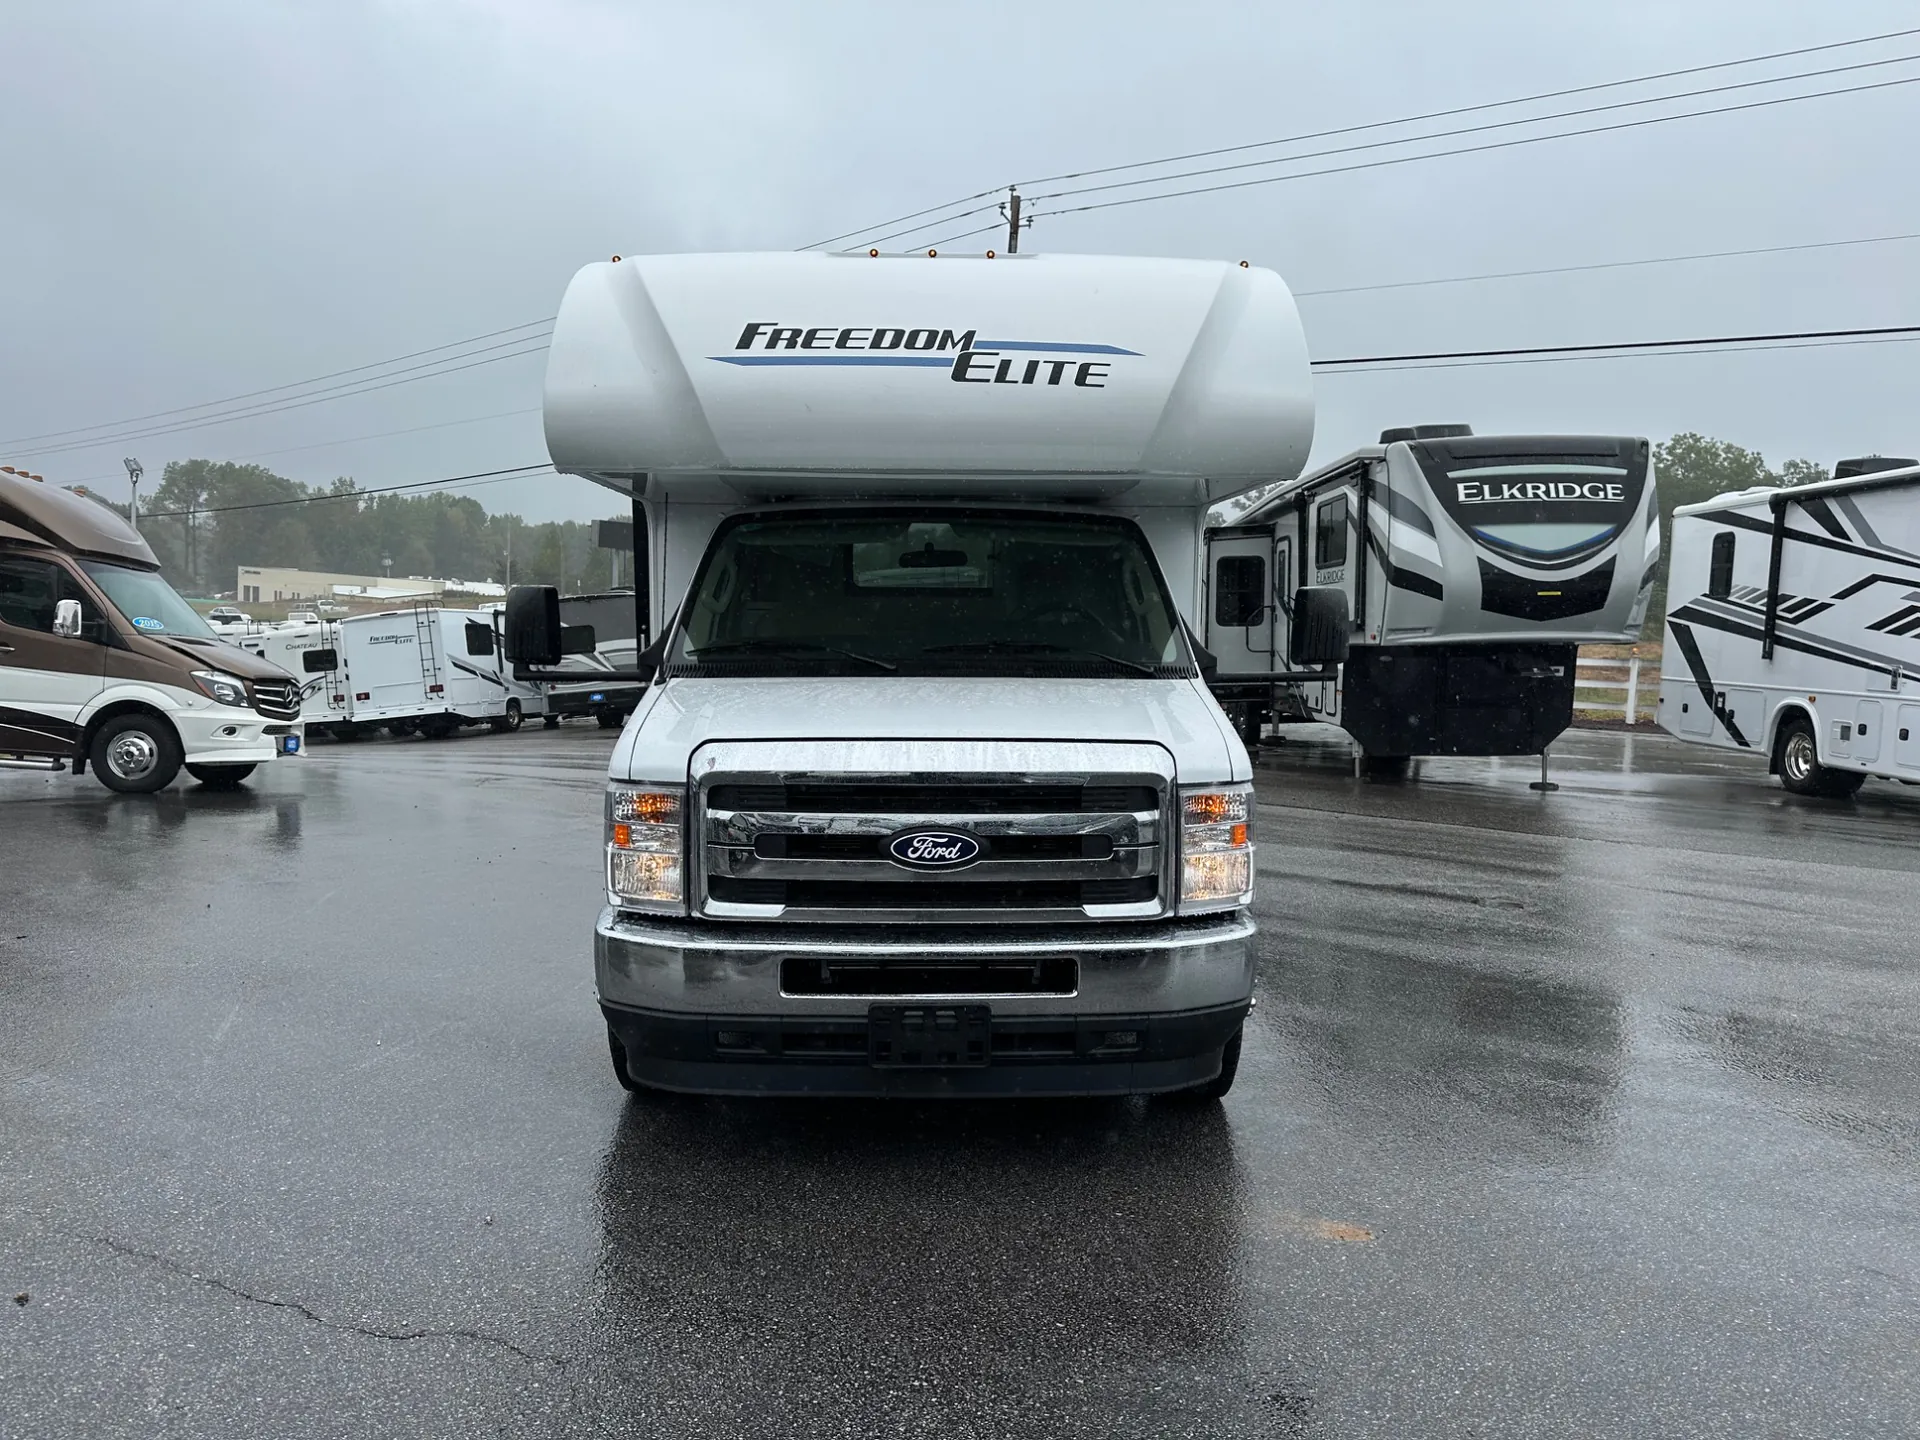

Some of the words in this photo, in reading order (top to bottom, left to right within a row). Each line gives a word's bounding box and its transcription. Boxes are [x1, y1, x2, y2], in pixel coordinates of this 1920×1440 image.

[734, 321, 977, 352] FREEDOM
[951, 351, 1112, 388] ELITE
[1456, 481, 1626, 502] ELKRIDGE
[285, 642, 319, 651] CHATEAU
[907, 836, 962, 859] Ford
